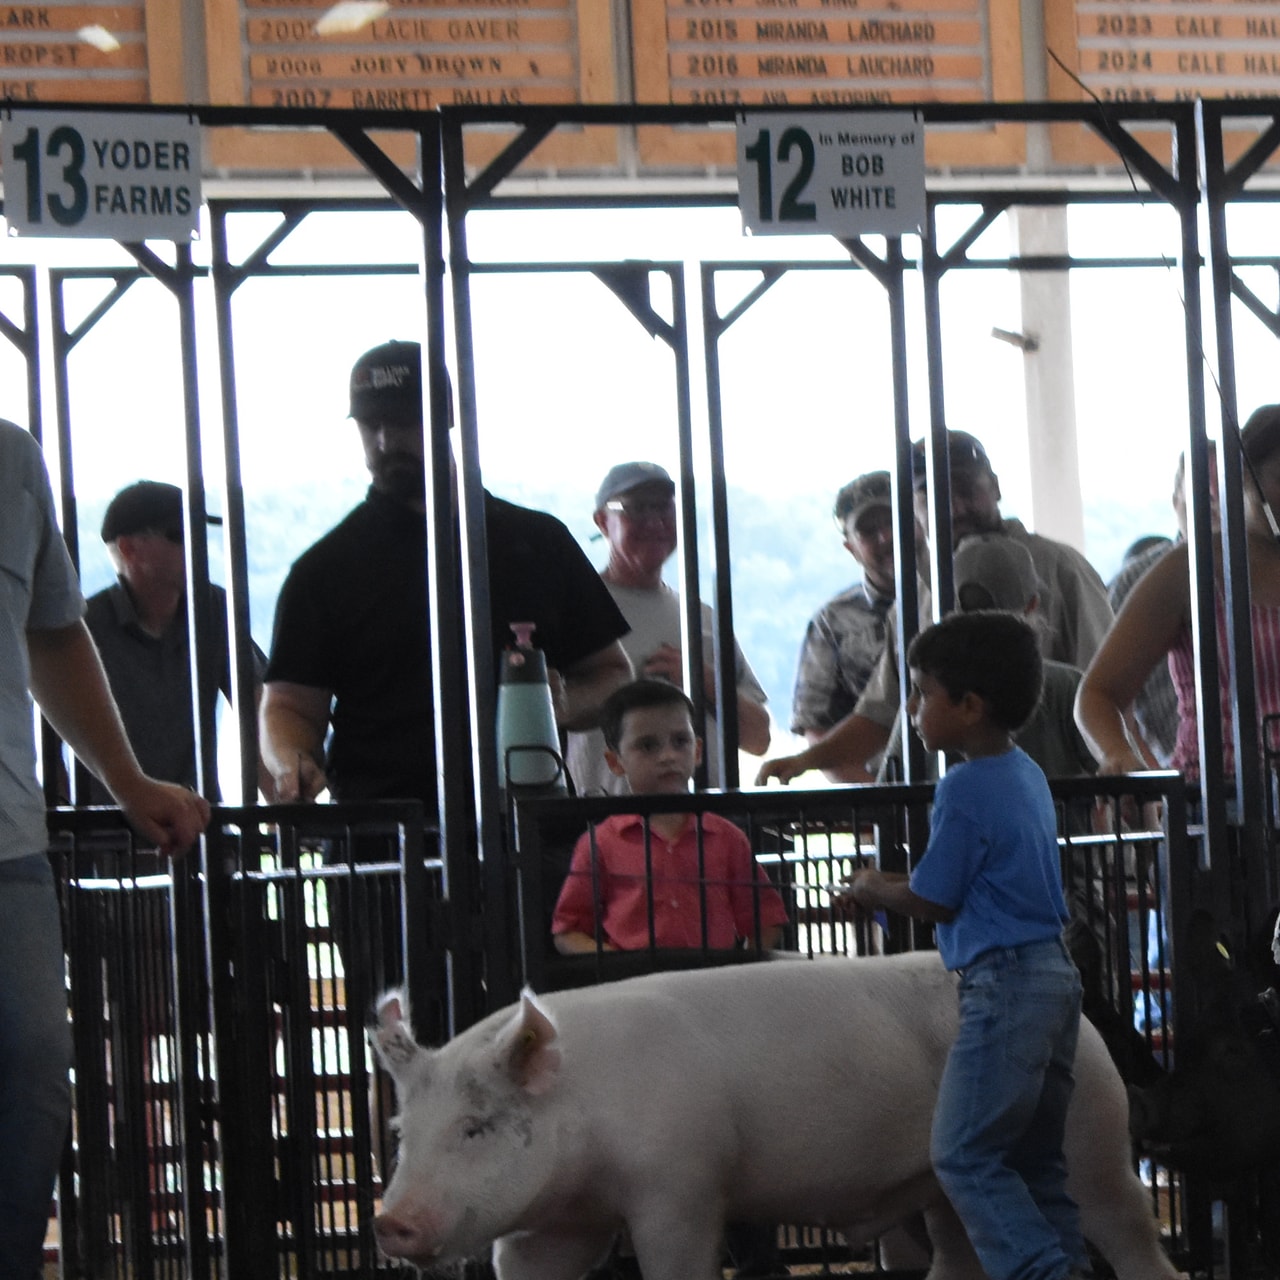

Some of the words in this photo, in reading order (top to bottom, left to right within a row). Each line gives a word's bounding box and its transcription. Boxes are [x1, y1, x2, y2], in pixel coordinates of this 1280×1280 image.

[0, 8, 49, 27] ARK
[1097, 15, 1153, 37] 2023
[1176, 16, 1222, 38] CALE
[687, 19, 738, 40] 2015
[756, 20, 829, 42] MIRANDA
[0, 45, 79, 65] ROPST
[350, 54, 406, 75] JOEY
[687, 55, 738, 76] 2016
[757, 55, 828, 77] MIRANDA
[1098, 51, 1153, 73] 2024
[1177, 52, 1225, 75] CALE
[818, 131, 833, 146] In
[838, 131, 896, 147] Memory
[901, 131, 916, 145] of
[93, 140, 190, 170] YODER
[842, 154, 884, 177] BOB
[13, 126, 88, 226] 13
[745, 126, 816, 222] 12
[95, 185, 192, 215] FARMS
[831, 187, 897, 210] WHITE
